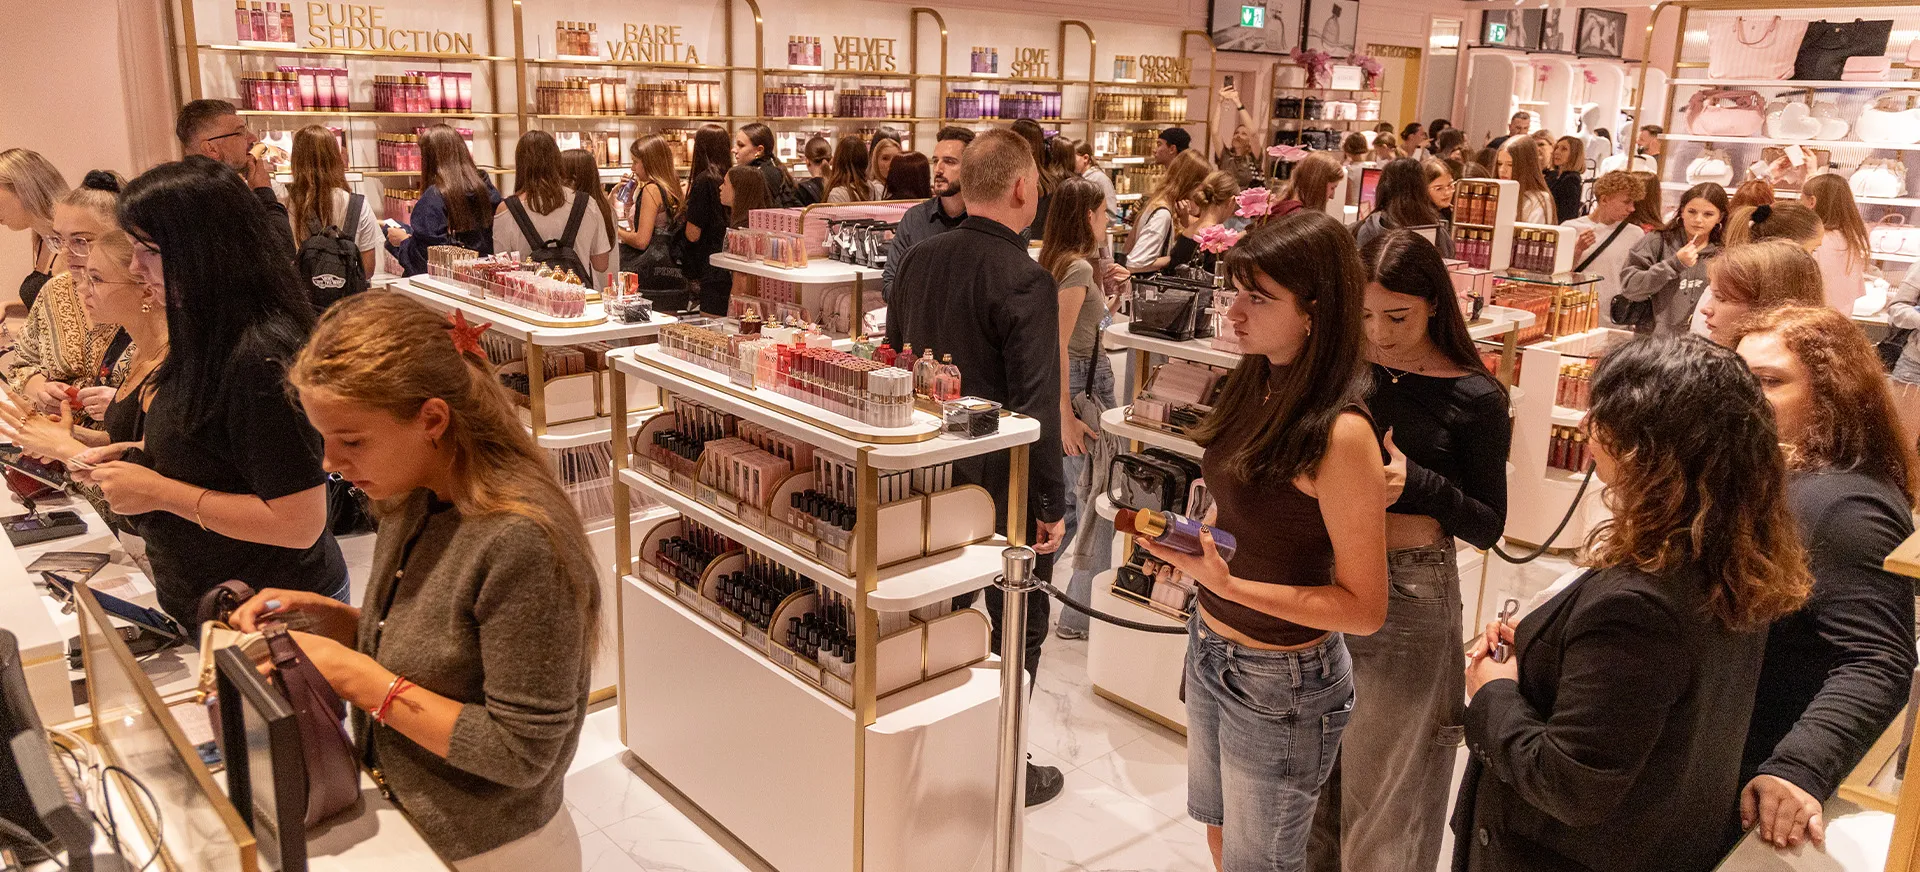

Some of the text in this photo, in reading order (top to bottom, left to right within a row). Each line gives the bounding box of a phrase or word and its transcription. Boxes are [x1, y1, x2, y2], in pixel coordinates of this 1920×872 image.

[307, 2, 385, 28] PURE
[308, 26, 473, 53] SEDUCTION
[624, 23, 683, 45] BARE
[607, 41, 699, 63] VANILLA
[833, 36, 896, 55] VELVET
[834, 52, 896, 71] PETALS
[1015, 47, 1049, 64] LOVE
[1140, 55, 1192, 71] COCONUT
[1011, 61, 1049, 77] SPELL
[1143, 68, 1190, 83] PASSION
